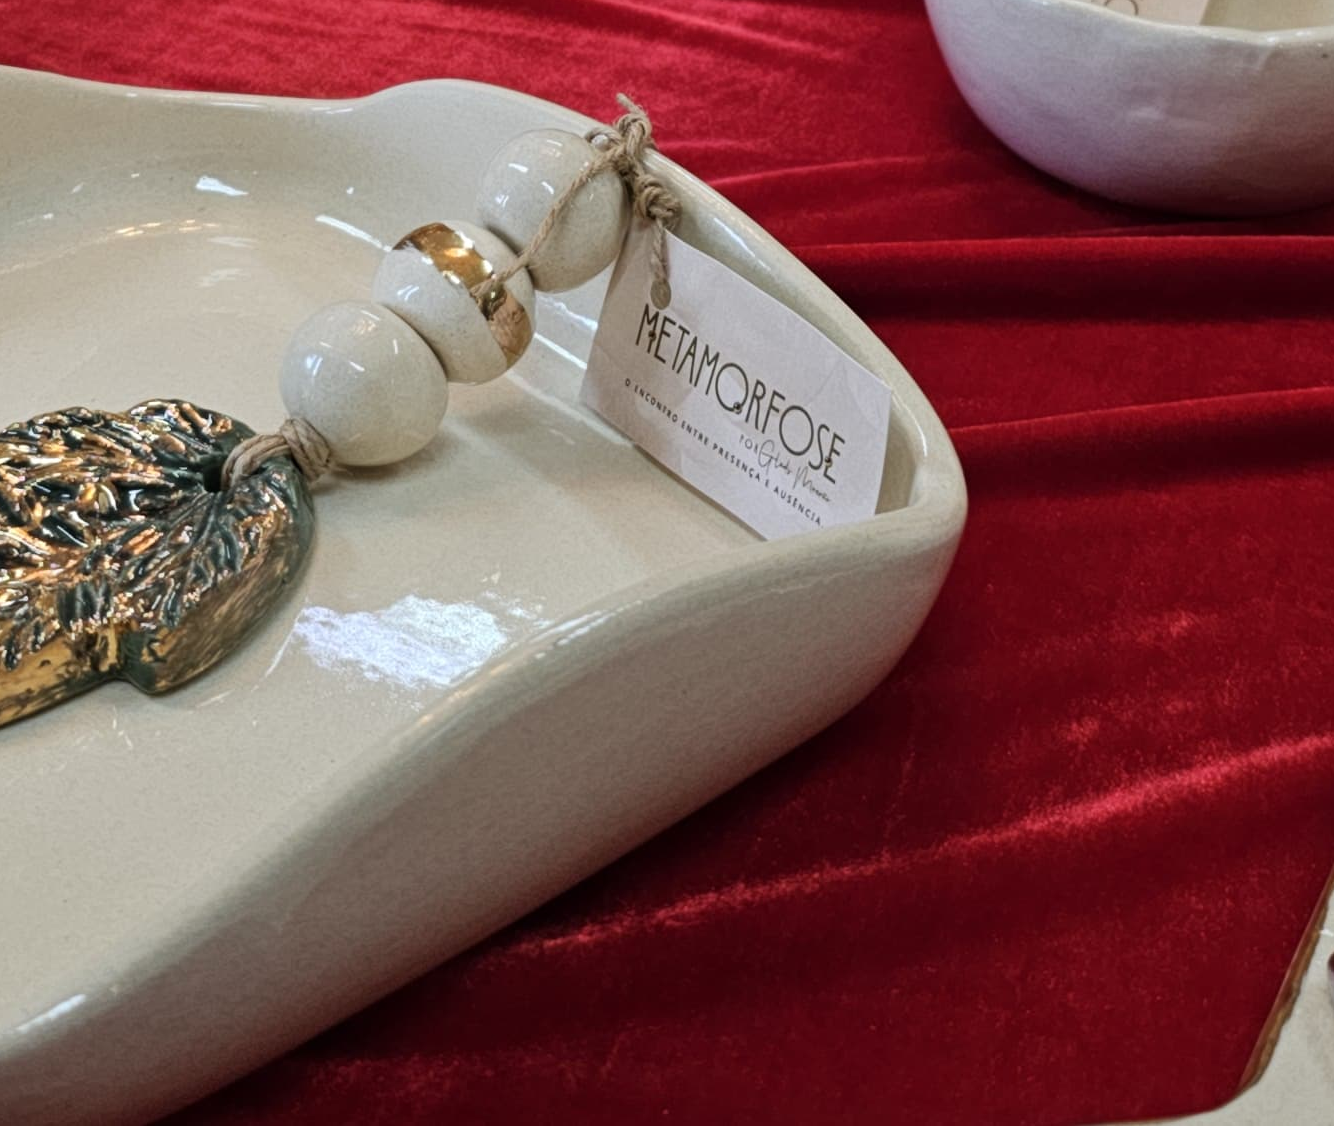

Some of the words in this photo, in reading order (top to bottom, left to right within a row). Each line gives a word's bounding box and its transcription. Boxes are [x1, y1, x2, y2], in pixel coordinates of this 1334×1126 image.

[633, 385, 679, 423] ENCONTRO
[680, 420, 709, 446] ENTRE
[635, 303, 846, 485] METAMORFOSE
